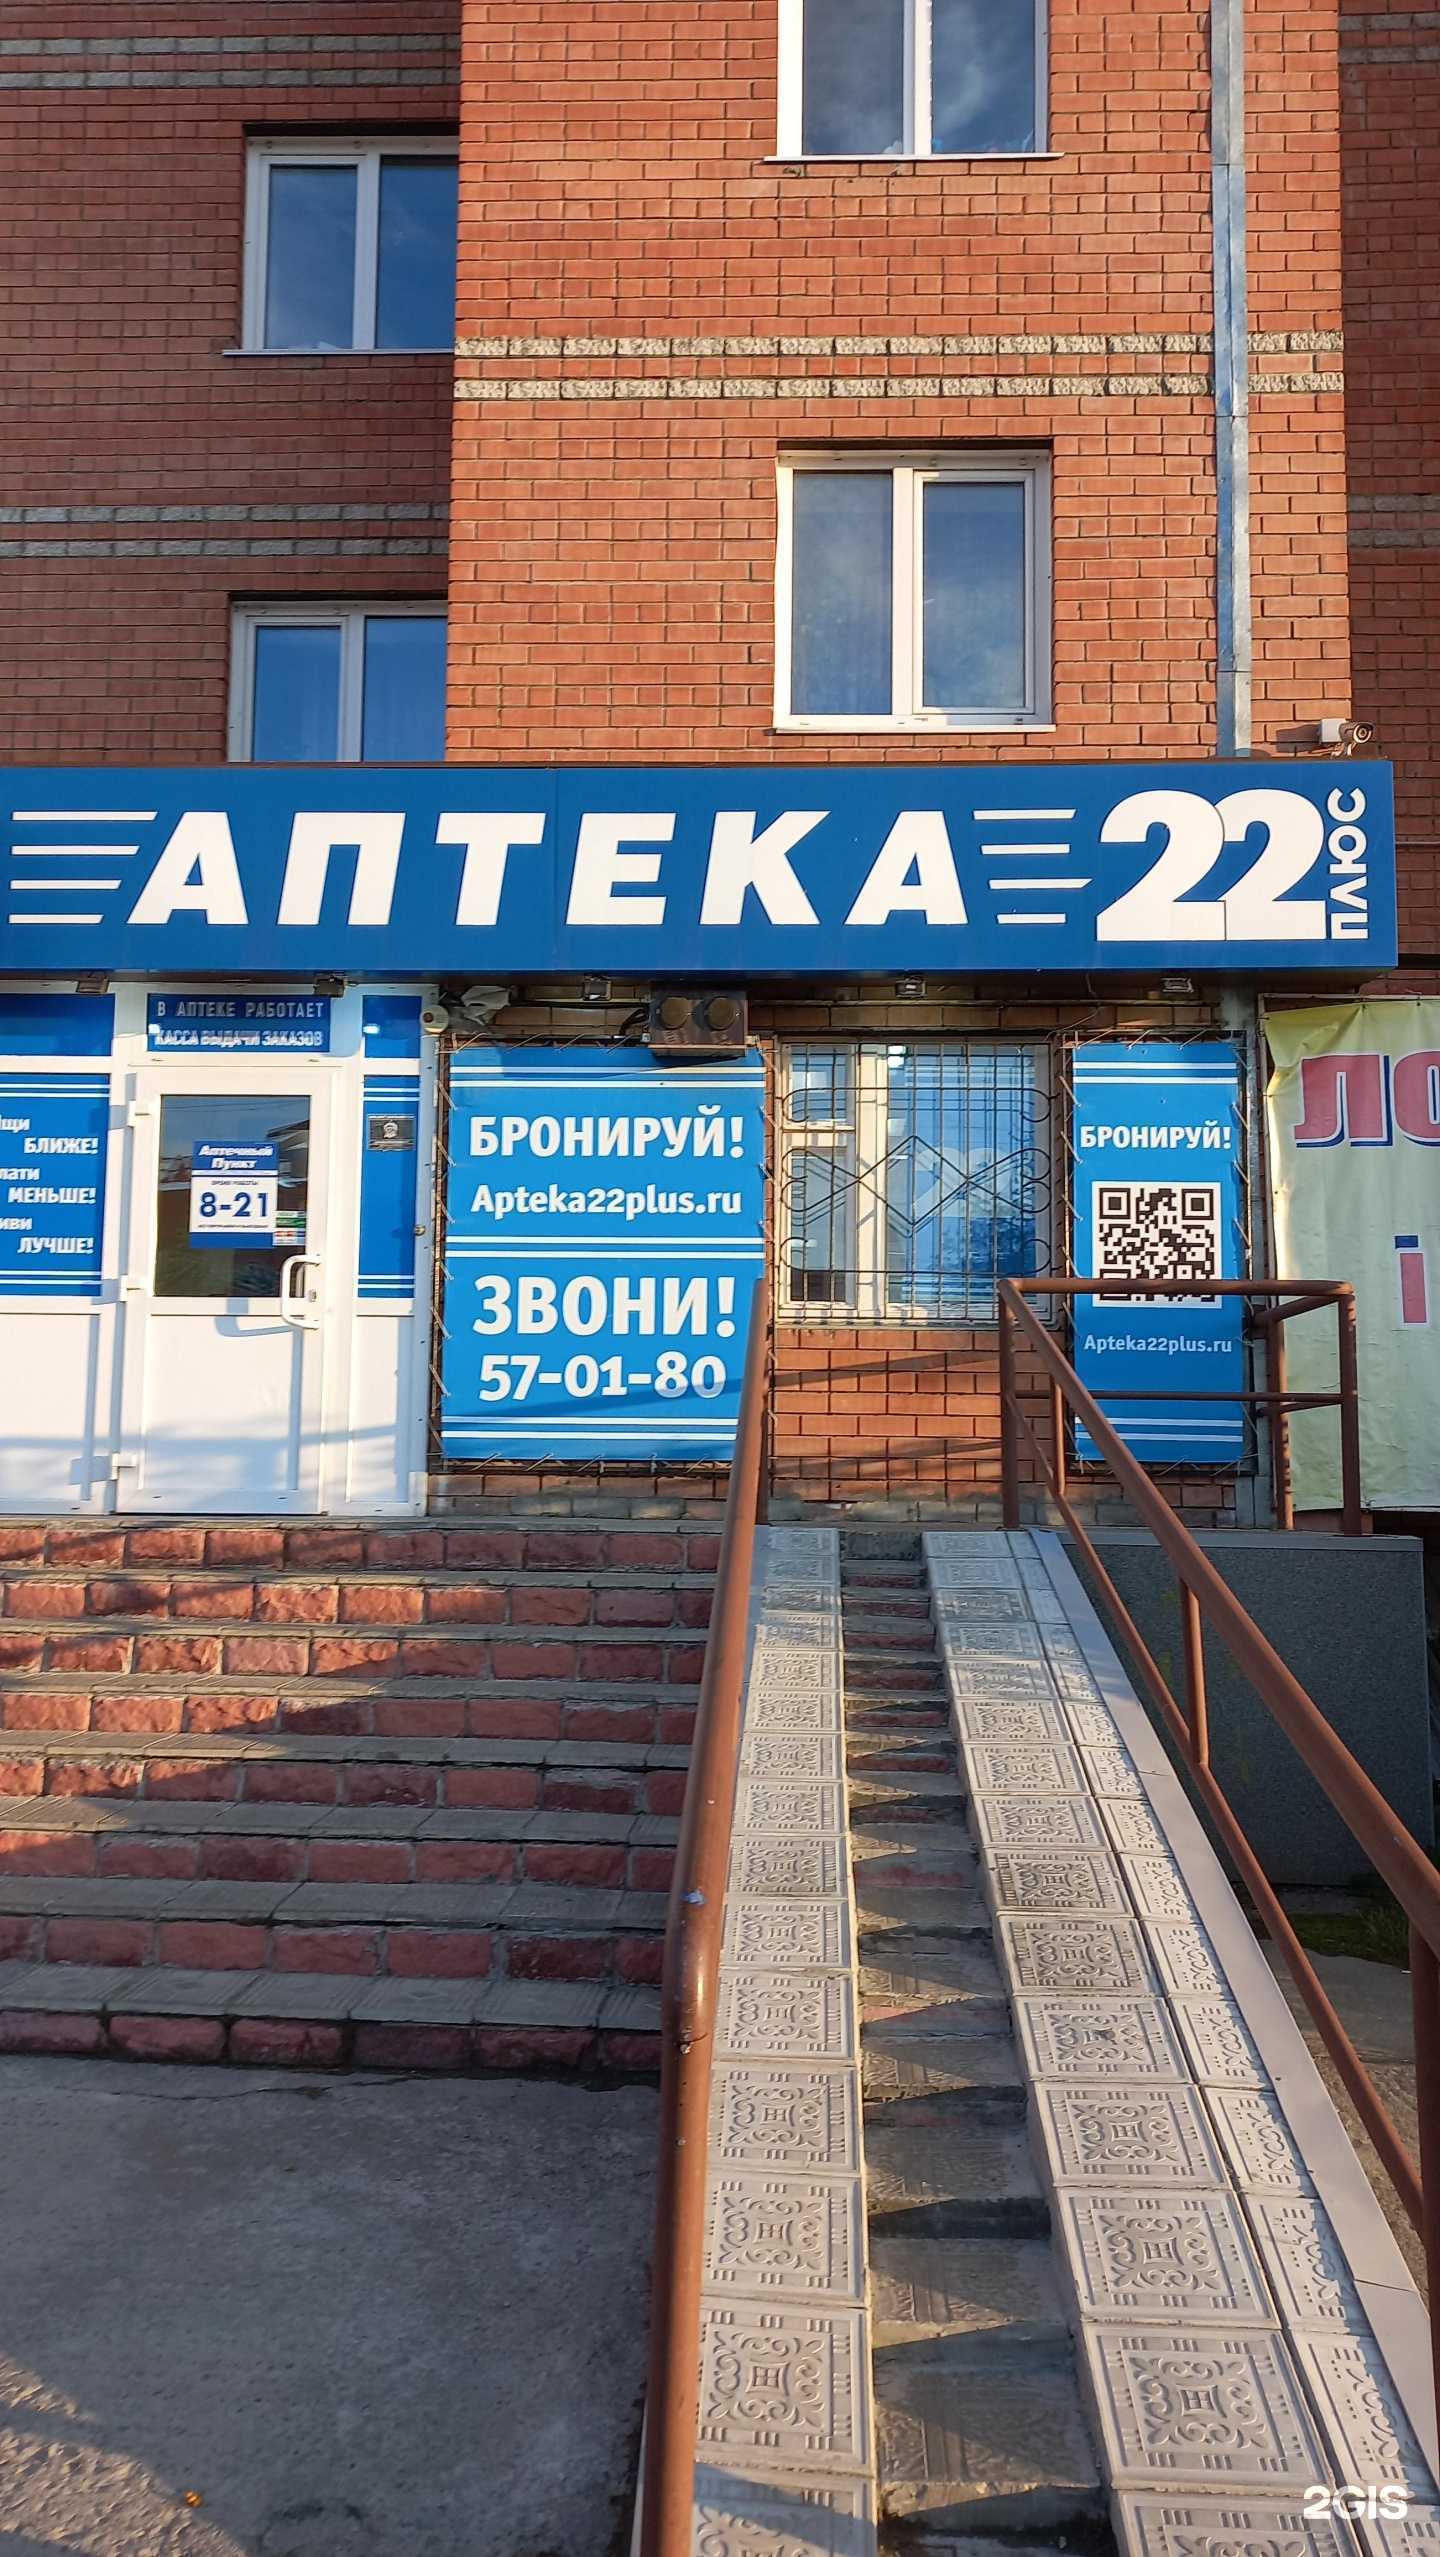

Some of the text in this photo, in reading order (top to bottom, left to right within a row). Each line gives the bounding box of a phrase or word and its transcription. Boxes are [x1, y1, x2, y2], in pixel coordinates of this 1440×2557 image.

[126, 788, 1327, 942] АПТЕКА 22
[1327, 787, 1369, 941] ПЛЮС
[157, 1001, 324, 1018] В АПТЕКЕ РАБОТАЕТ
[155, 1029, 199, 1046] КАССА
[262, 1030, 323, 1047] ЗАКАЗОВ
[469, 1104, 744, 1159] БРОНИРУЙ!
[1080, 1120, 1232, 1150] БРОНИРУЙ!
[24, 1137, 99, 1155] БЛИЖЕ!
[8, 1186, 97, 1205] МЕНЬШЕ!
[200, 1191, 269, 1218] 8-21
[470, 1184, 742, 1221] Apteka22plus.ru
[17, 1237, 94, 1255] ЛУЧШЕ!
[472, 1275, 737, 1339] ЗВОНИ!
[1084, 1334, 1232, 1355] Apteka22plus.ru
[478, 1351, 726, 1402] 57-01-80
